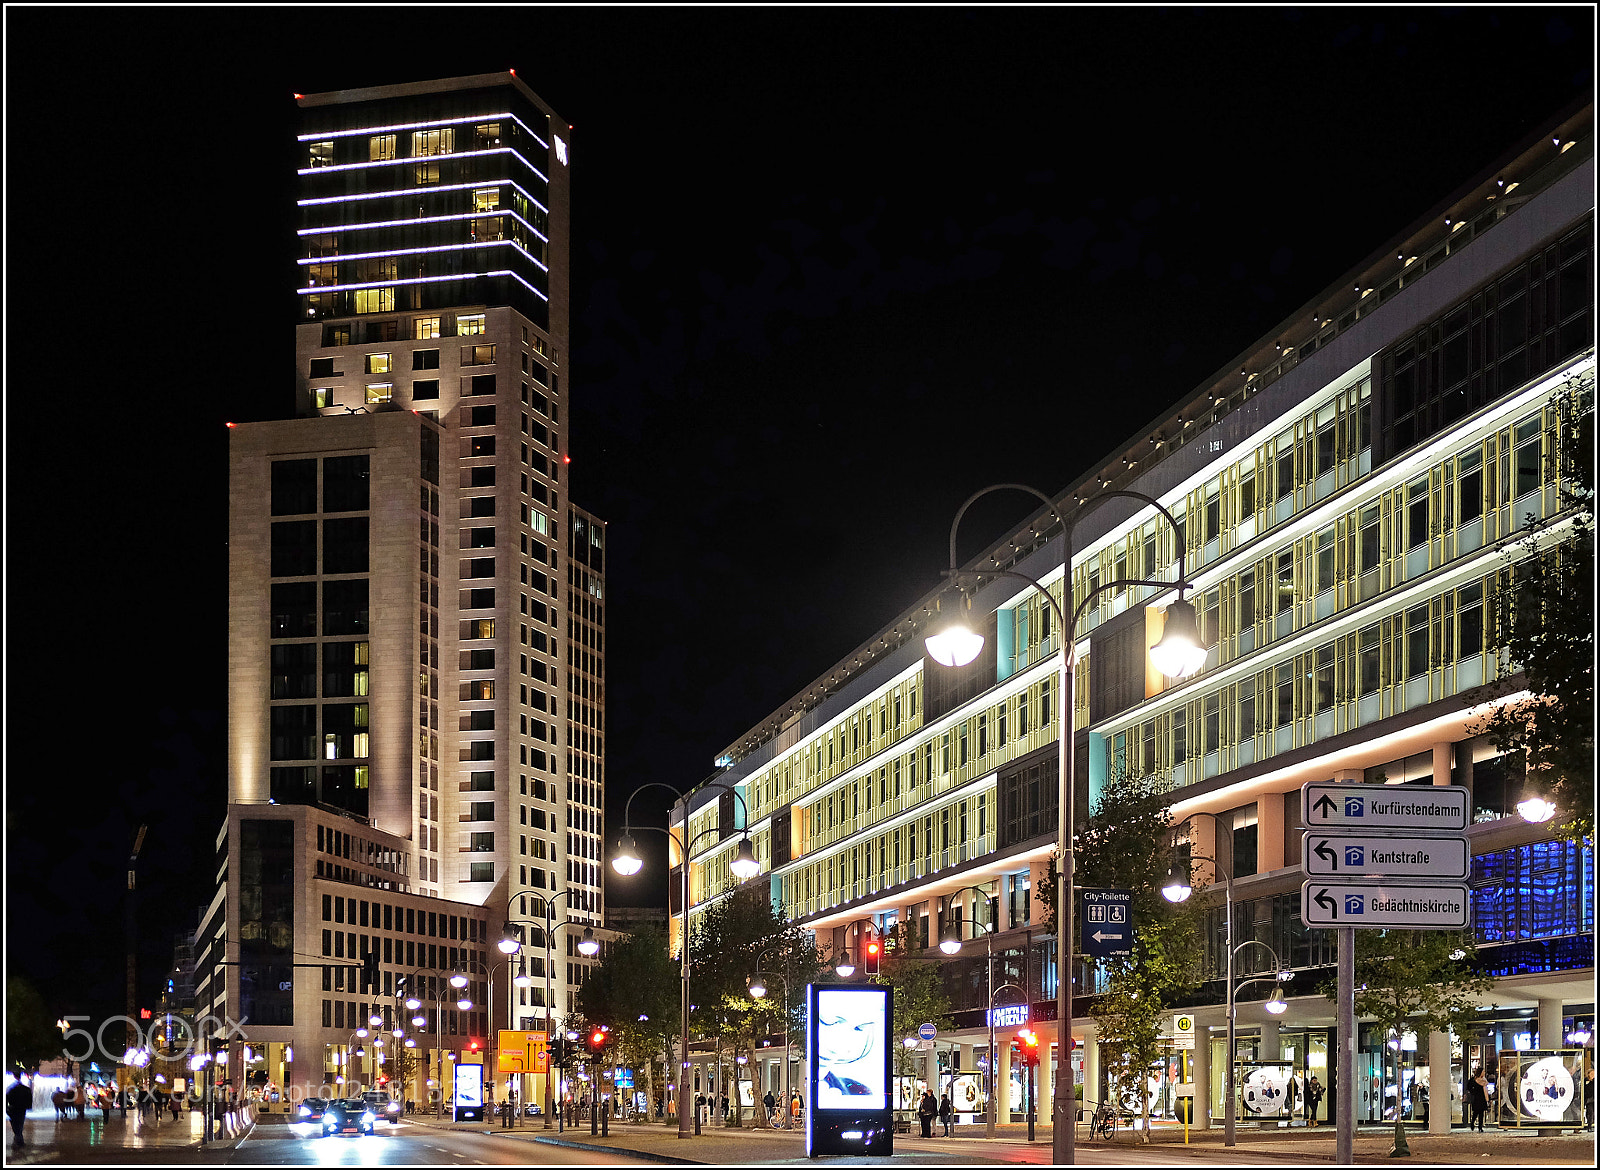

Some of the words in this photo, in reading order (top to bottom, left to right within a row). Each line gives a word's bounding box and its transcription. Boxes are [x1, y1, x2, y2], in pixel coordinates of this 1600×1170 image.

[1371, 801, 1460, 817] Kurfürstendamm
[1371, 849, 1430, 864] Kantstraße
[1084, 892, 1130, 902] City-Toilette
[1371, 899, 1460, 914] Gedächtniskirche
